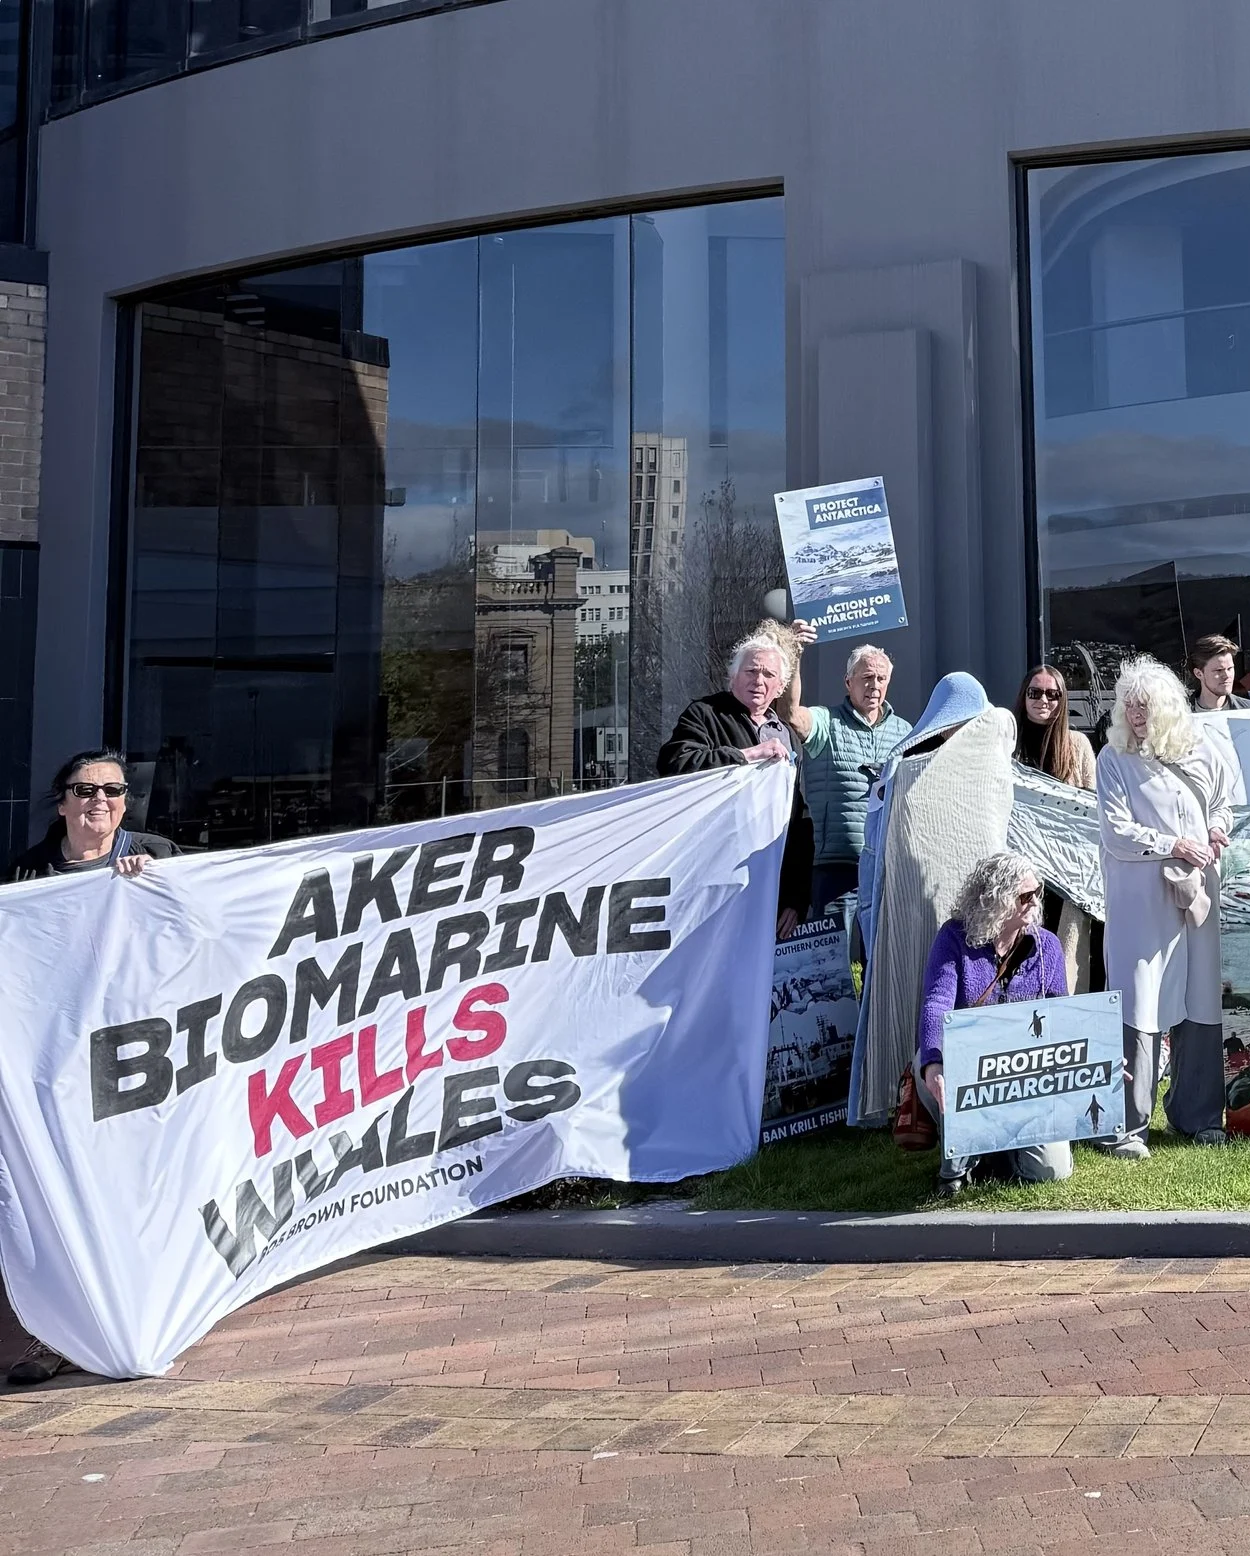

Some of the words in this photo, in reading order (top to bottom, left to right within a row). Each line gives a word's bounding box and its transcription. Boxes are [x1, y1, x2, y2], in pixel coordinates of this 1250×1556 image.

[812, 497, 859, 513] PROTECT
[815, 504, 881, 523] ANTARCTICA
[810, 607, 877, 627] ANTARCTICA
[826, 598, 867, 614] ACTION
[869, 594, 892, 606] FOR
[268, 826, 536, 959] AKER
[789, 918, 836, 938] NTARTICA
[775, 942, 812, 957] OUTHERN
[813, 935, 840, 948] OCEAN
[90, 877, 671, 1122] BIOMARINE
[247, 981, 510, 1159] KILLS
[982, 1042, 1086, 1078] PROTECT
[960, 1065, 1106, 1109] ANTARCTICA
[763, 1126, 787, 1143] BAN
[790, 1117, 818, 1135] KRILL
[286, 1199, 346, 1241] BROWN
[351, 1155, 484, 1213] FOUNDATION
